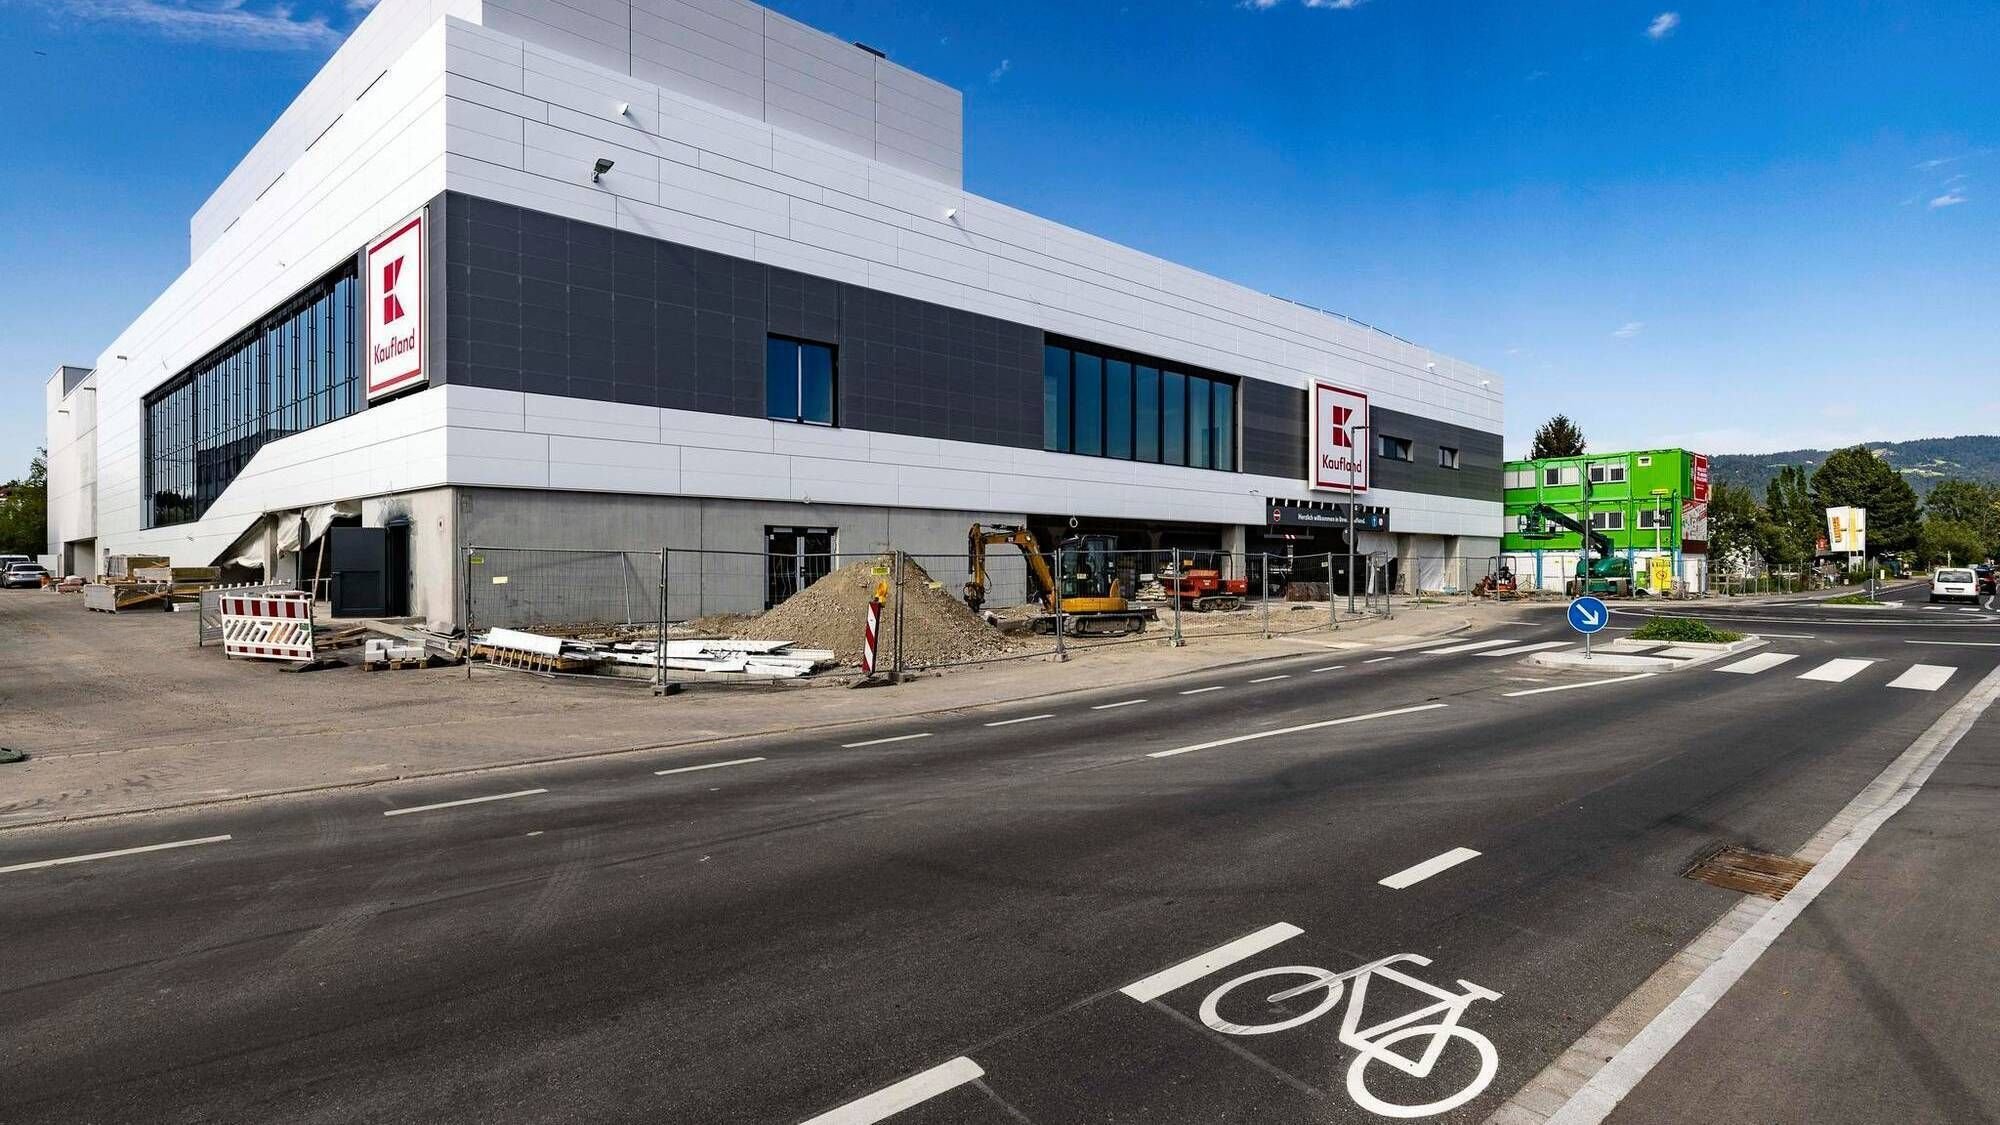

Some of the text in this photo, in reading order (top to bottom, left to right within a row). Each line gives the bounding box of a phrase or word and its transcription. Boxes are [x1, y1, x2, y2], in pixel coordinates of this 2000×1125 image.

[383, 255, 405, 325] K
[374, 327, 415, 365] Kaufland
[1332, 405, 1353, 448] K
